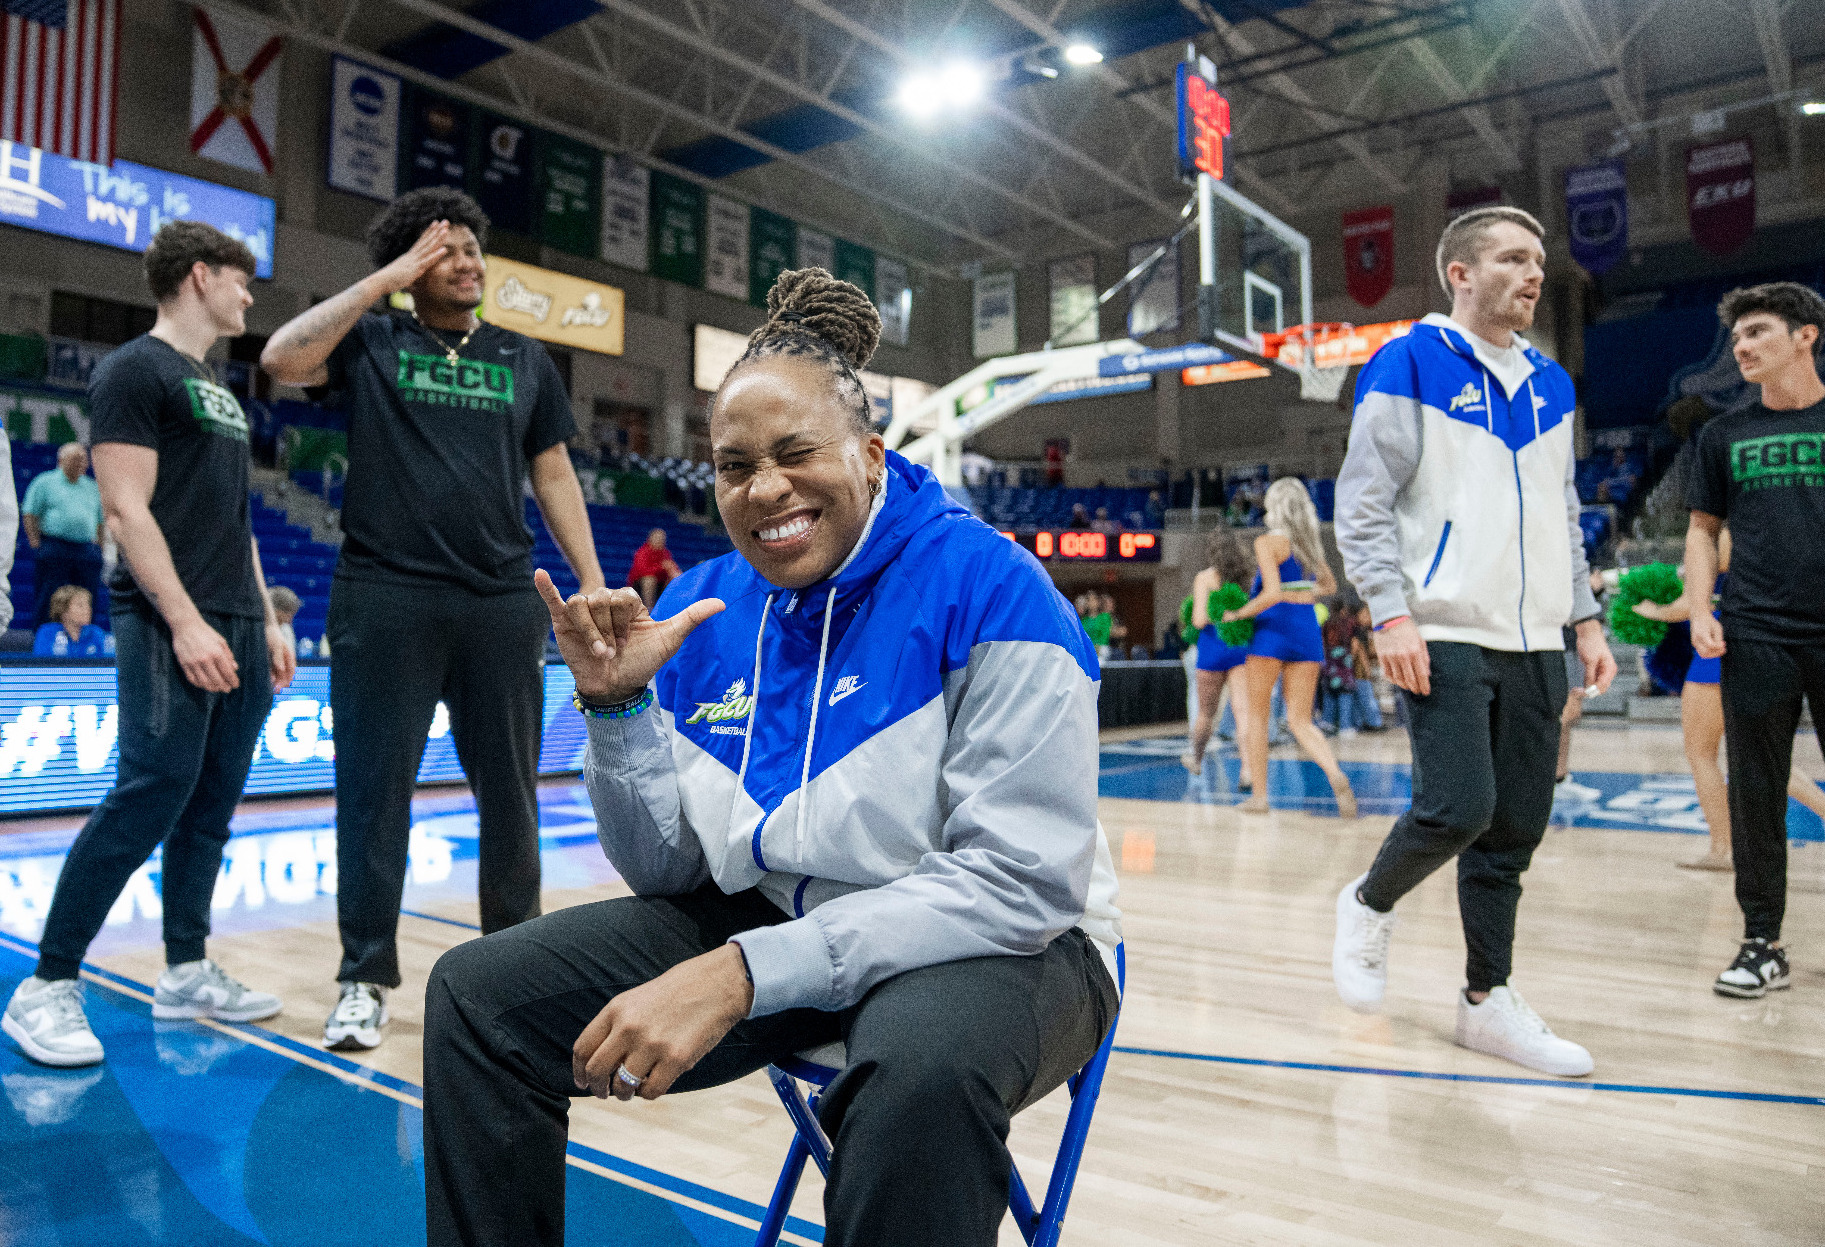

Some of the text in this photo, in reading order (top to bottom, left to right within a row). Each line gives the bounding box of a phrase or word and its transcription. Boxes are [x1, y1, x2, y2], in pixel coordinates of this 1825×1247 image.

[68, 160, 150, 207] This
[406, 358, 507, 394] FGCU
[1740, 440, 1825, 474] FGC
[835, 675, 860, 693] NIKE
[686, 694, 754, 724] FGCU
[709, 725, 747, 736] BASKETBAL
